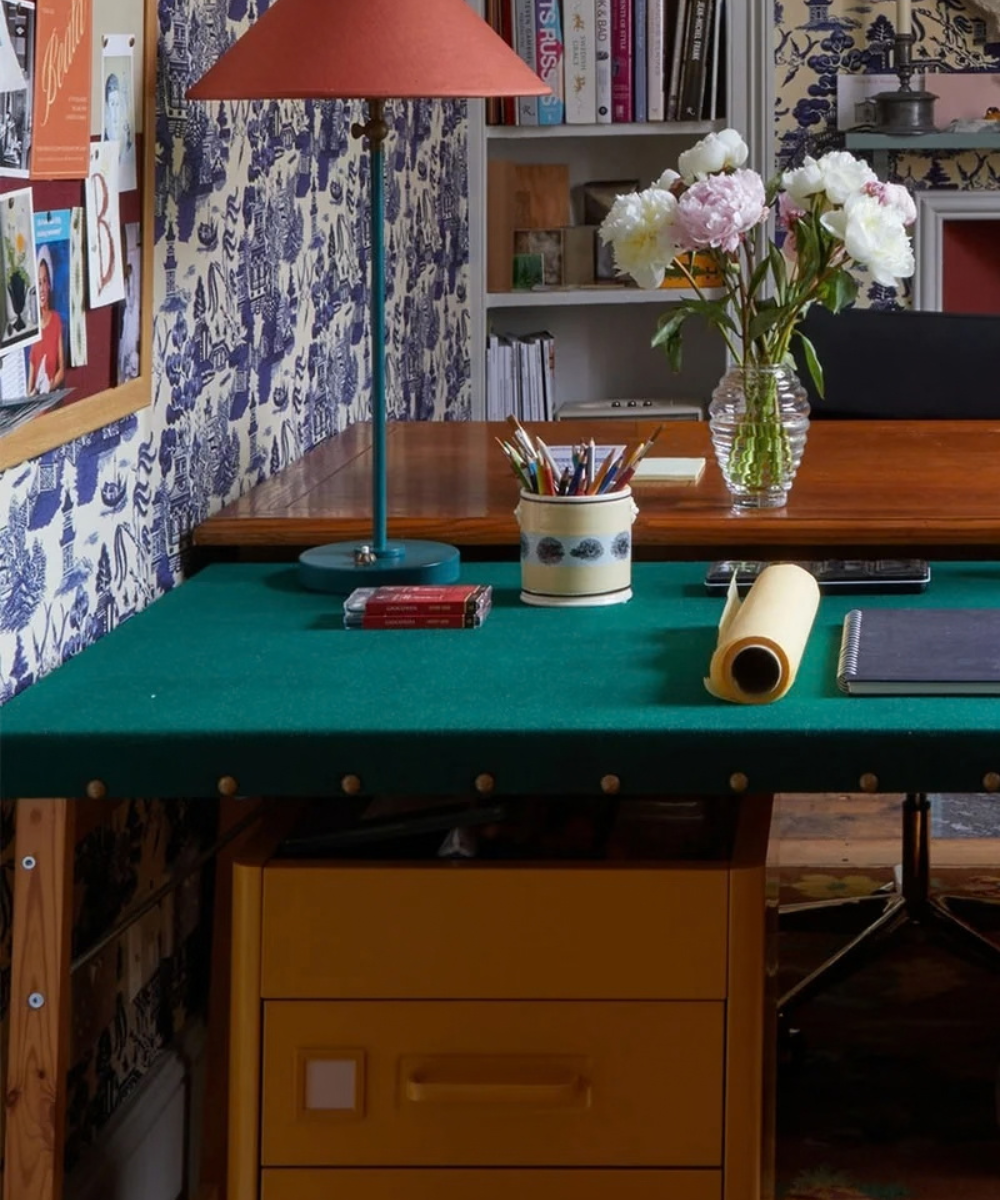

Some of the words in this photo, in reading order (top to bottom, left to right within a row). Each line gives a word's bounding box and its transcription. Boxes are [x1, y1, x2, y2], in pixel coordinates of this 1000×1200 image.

[598, 19, 607, 41] BAD
[620, 18, 626, 28] OF
[540, 28, 557, 106] RUSSS
